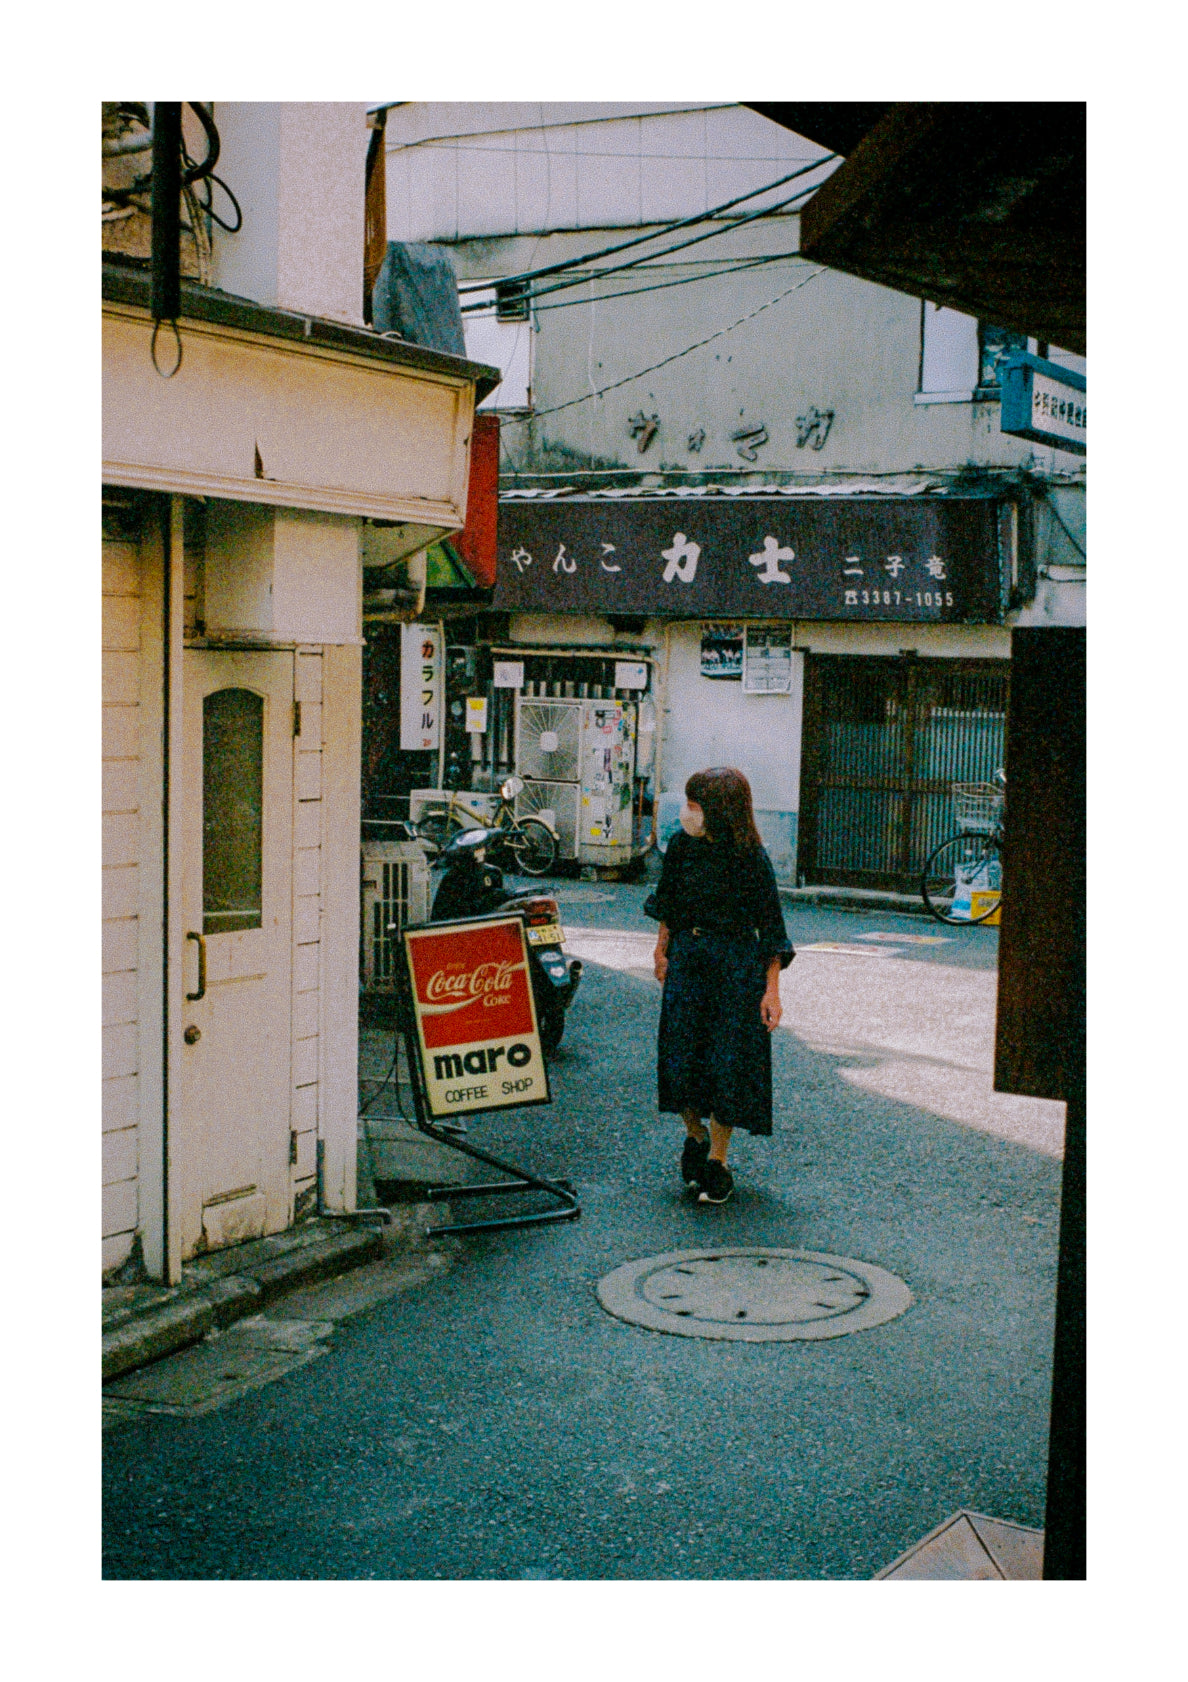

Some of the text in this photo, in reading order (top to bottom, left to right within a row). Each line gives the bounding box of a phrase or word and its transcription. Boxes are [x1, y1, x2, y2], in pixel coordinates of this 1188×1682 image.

[661, 532, 795, 584] 力士
[862, 590, 953, 607] 3387-1055
[420, 640, 436, 730] カラフル
[433, 1043, 532, 1080] maro
[445, 1077, 534, 1104] COFFEE SHOP
